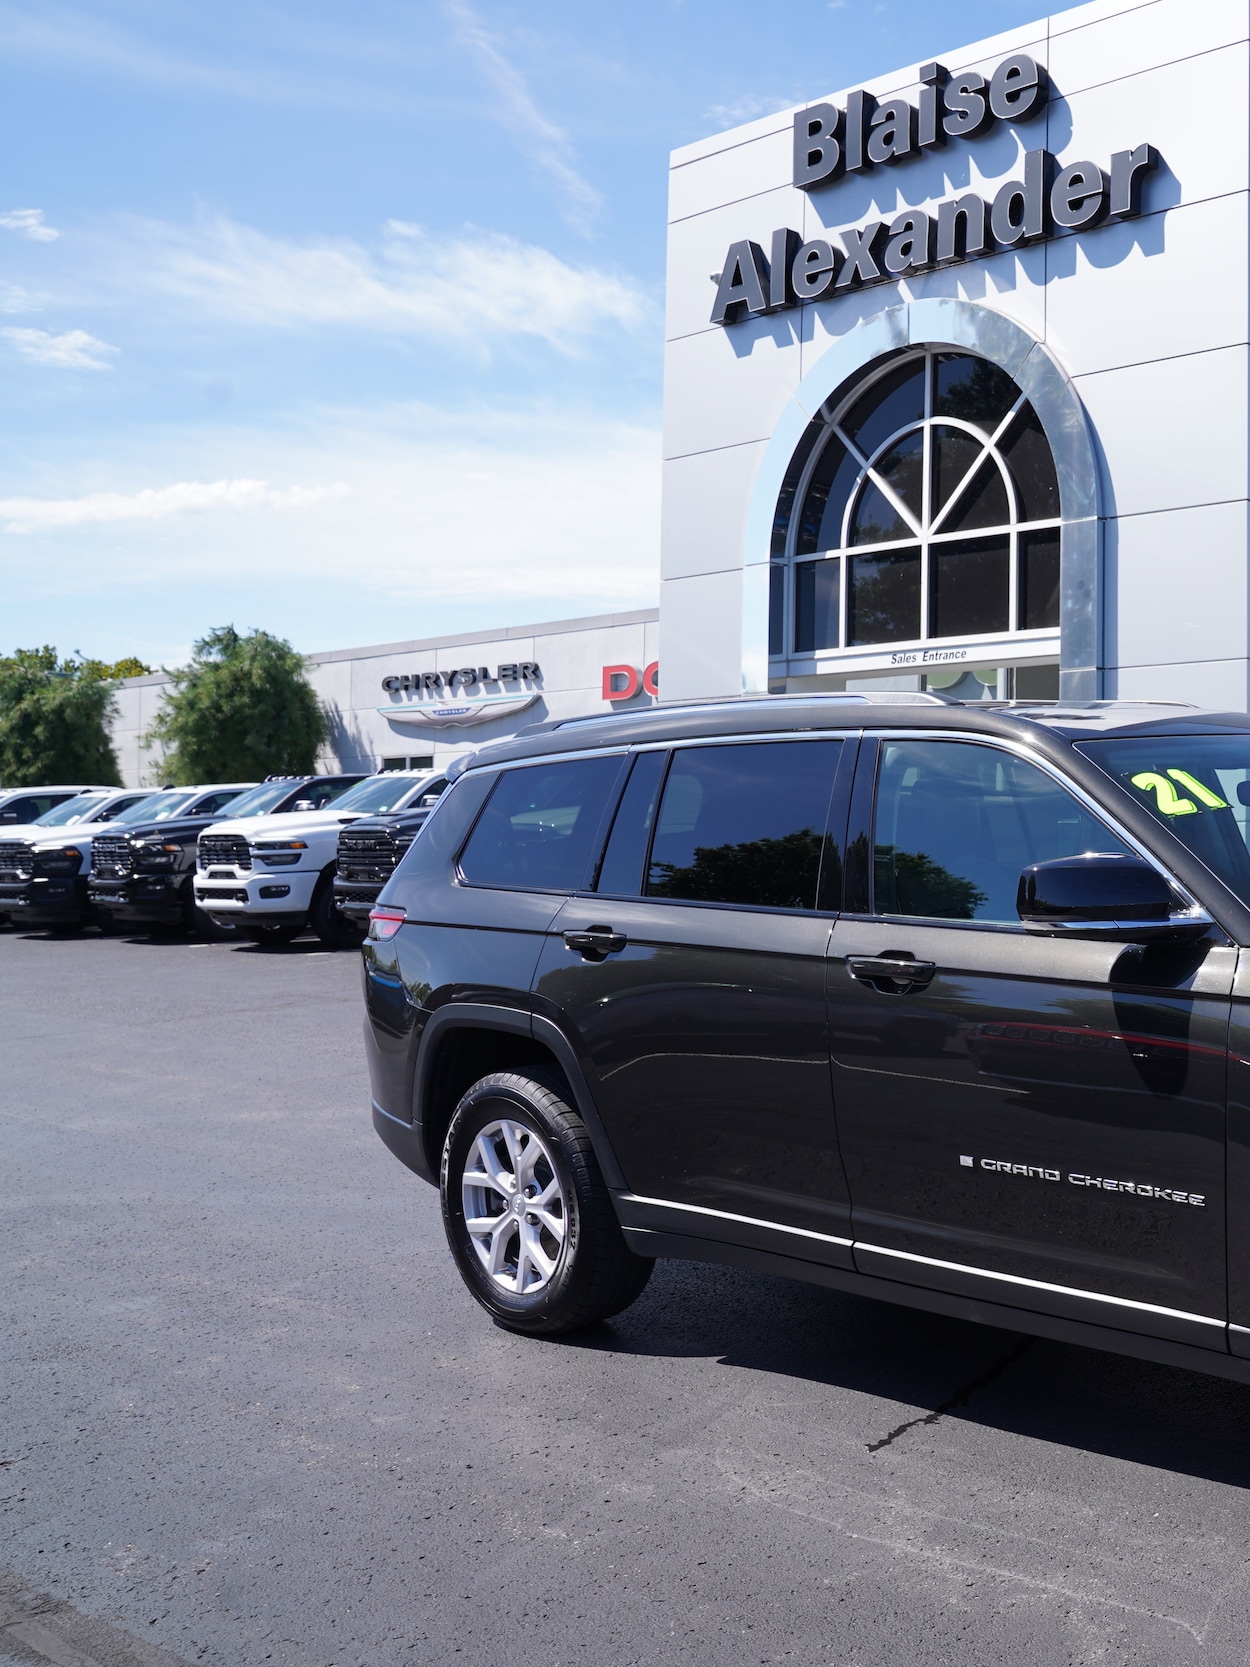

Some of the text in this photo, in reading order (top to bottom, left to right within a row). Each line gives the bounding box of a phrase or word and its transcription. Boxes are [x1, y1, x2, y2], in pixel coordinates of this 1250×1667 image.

[793, 53, 1048, 191] Blaise
[710, 143, 1158, 325] Alexander
[381, 662, 540, 694] CHRYSLER
[891, 650, 967, 665] Sales Entrance
[1131, 768, 1228, 815] 21
[980, 1158, 1206, 1207] GRAND CHEROKEE
